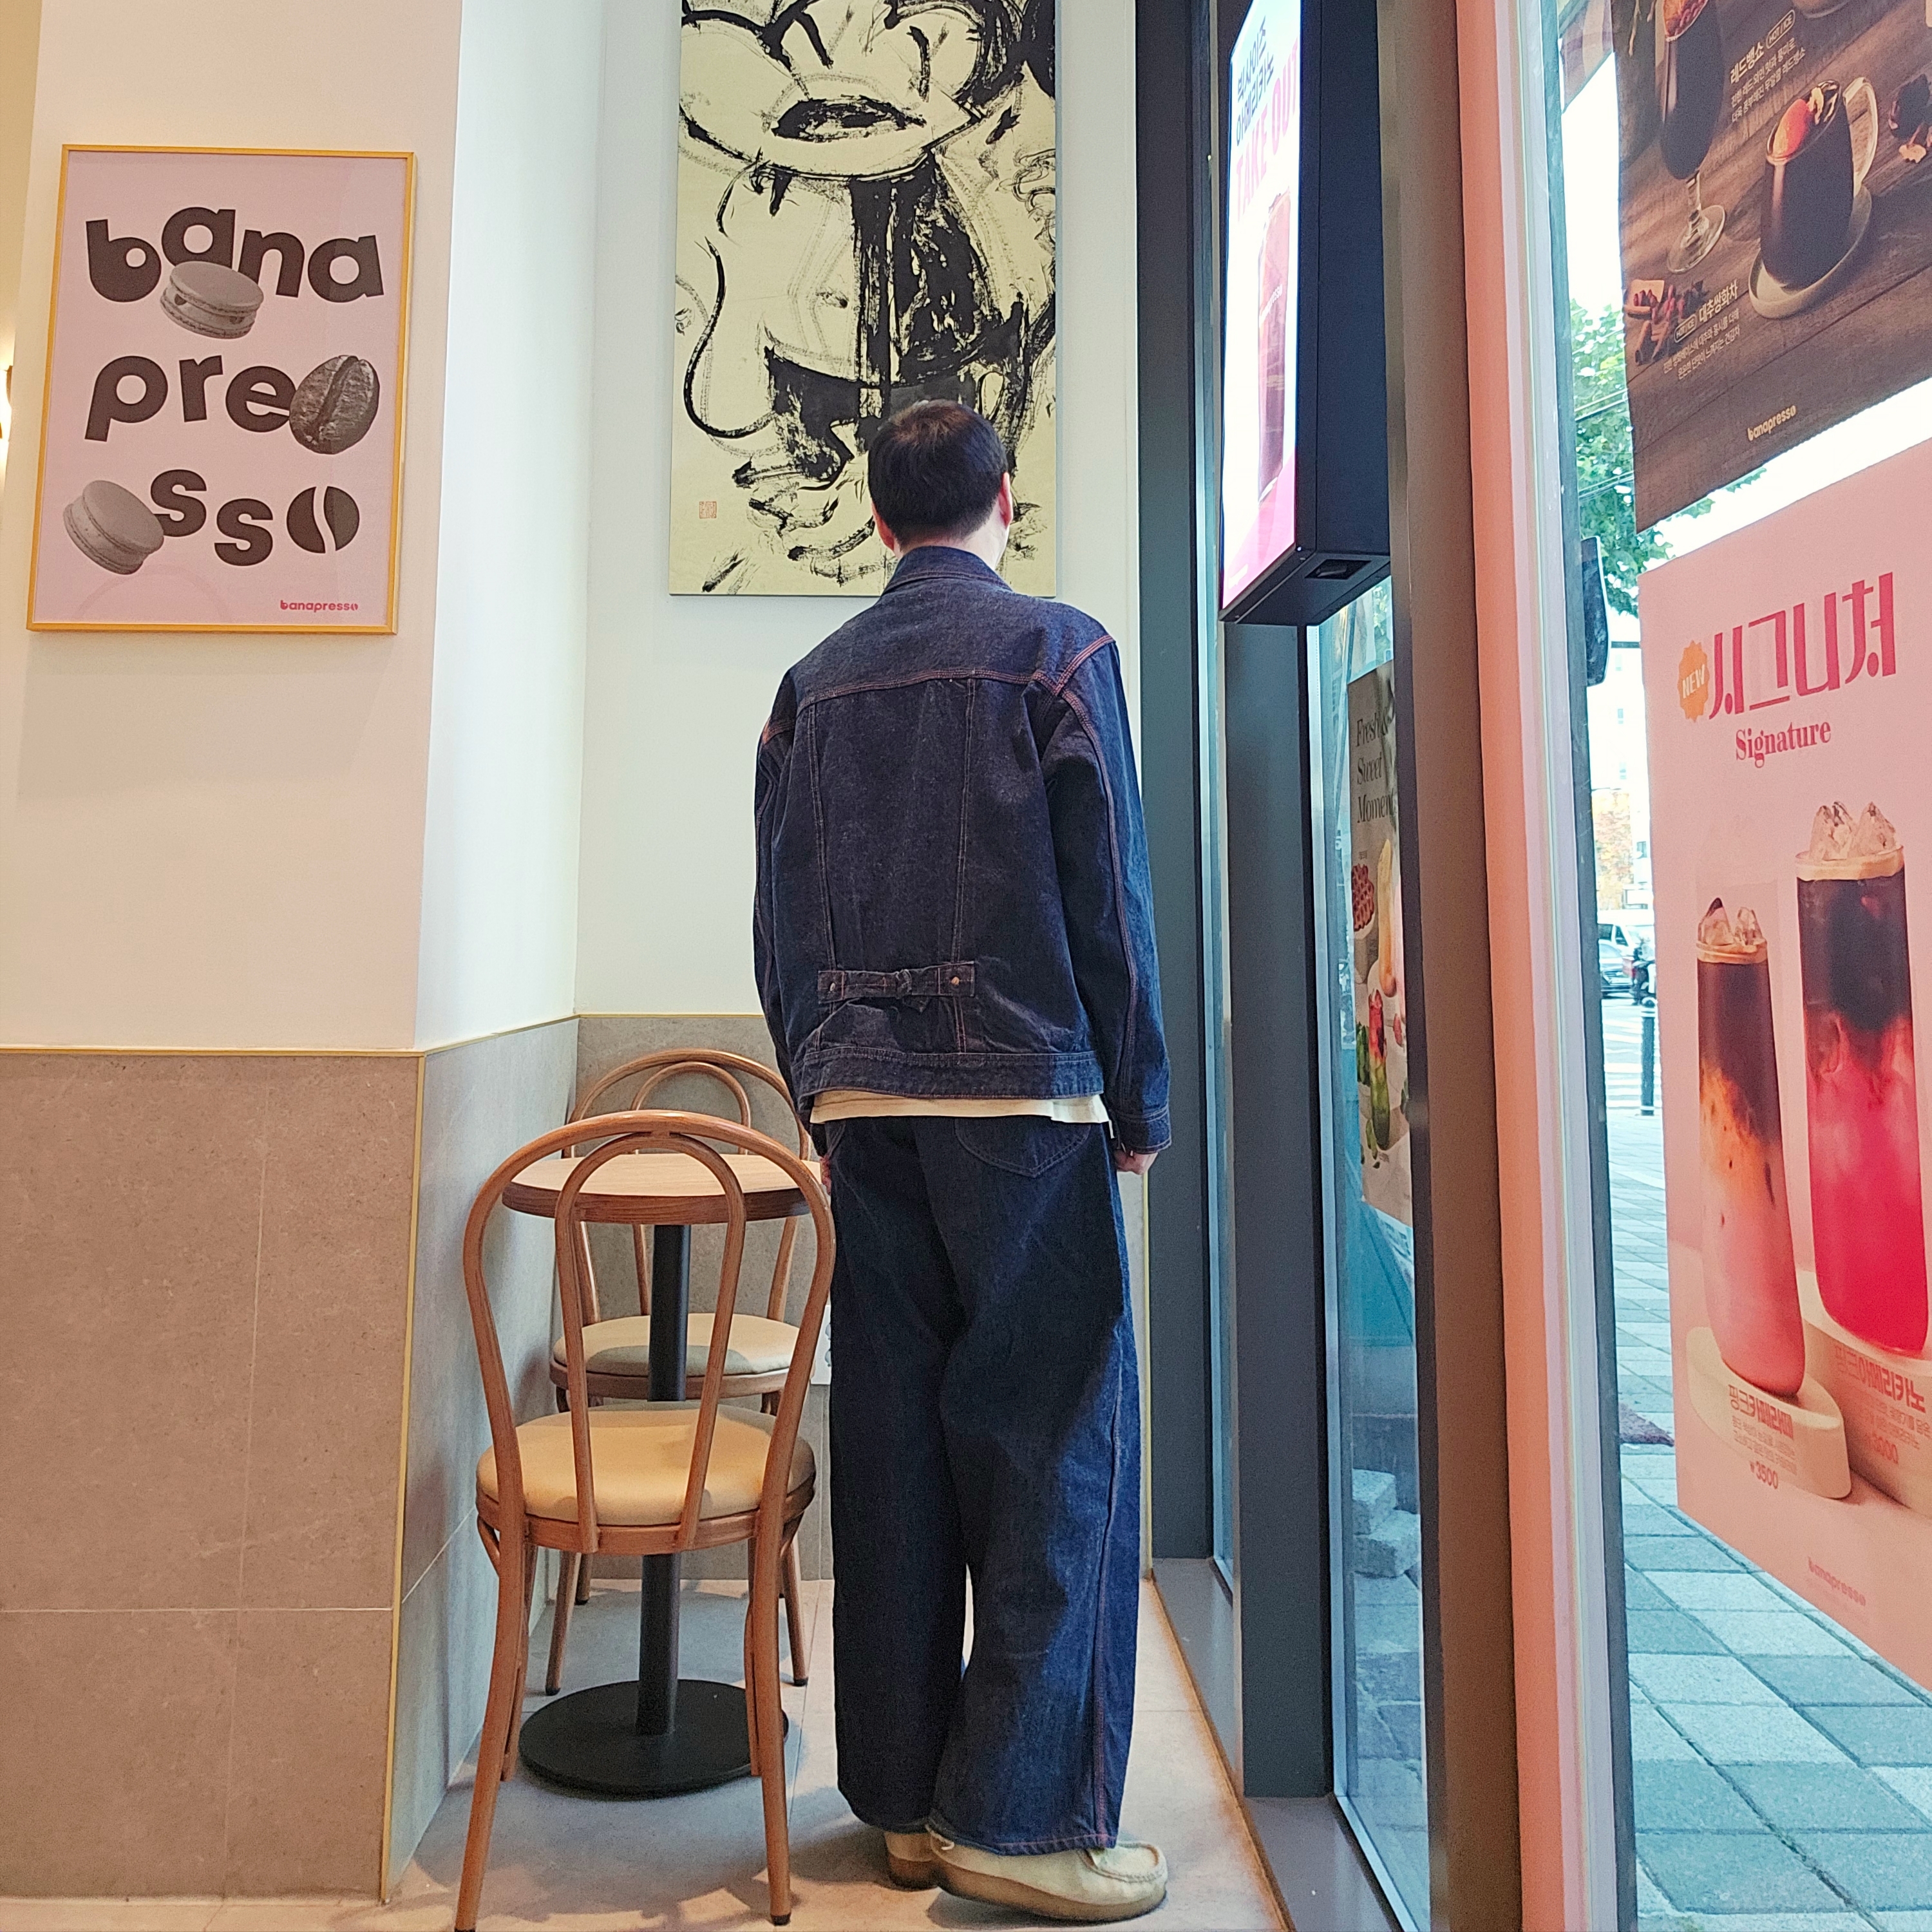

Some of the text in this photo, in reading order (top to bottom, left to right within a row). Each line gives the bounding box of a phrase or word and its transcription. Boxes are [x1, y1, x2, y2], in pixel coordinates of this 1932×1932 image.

[1730, 42, 1764, 84] 레드뱅쇼
[1783, 47, 1805, 75] 레드뱅쇼
[1236, 50, 1274, 147] 아메리카노
[1236, 35, 1298, 223] TAKE OUT
[86, 207, 384, 303] bana
[1700, 279, 1738, 322] 대추쌍화차
[85, 355, 297, 442] pre
[1747, 405, 1796, 441] banapresso
[280, 600, 359, 612] banapresso
[1682, 664, 1706, 699] NEW
[1356, 712, 1379, 746] Fresh
[1736, 721, 1832, 768] Signature
[1357, 751, 1382, 785] Sweet
